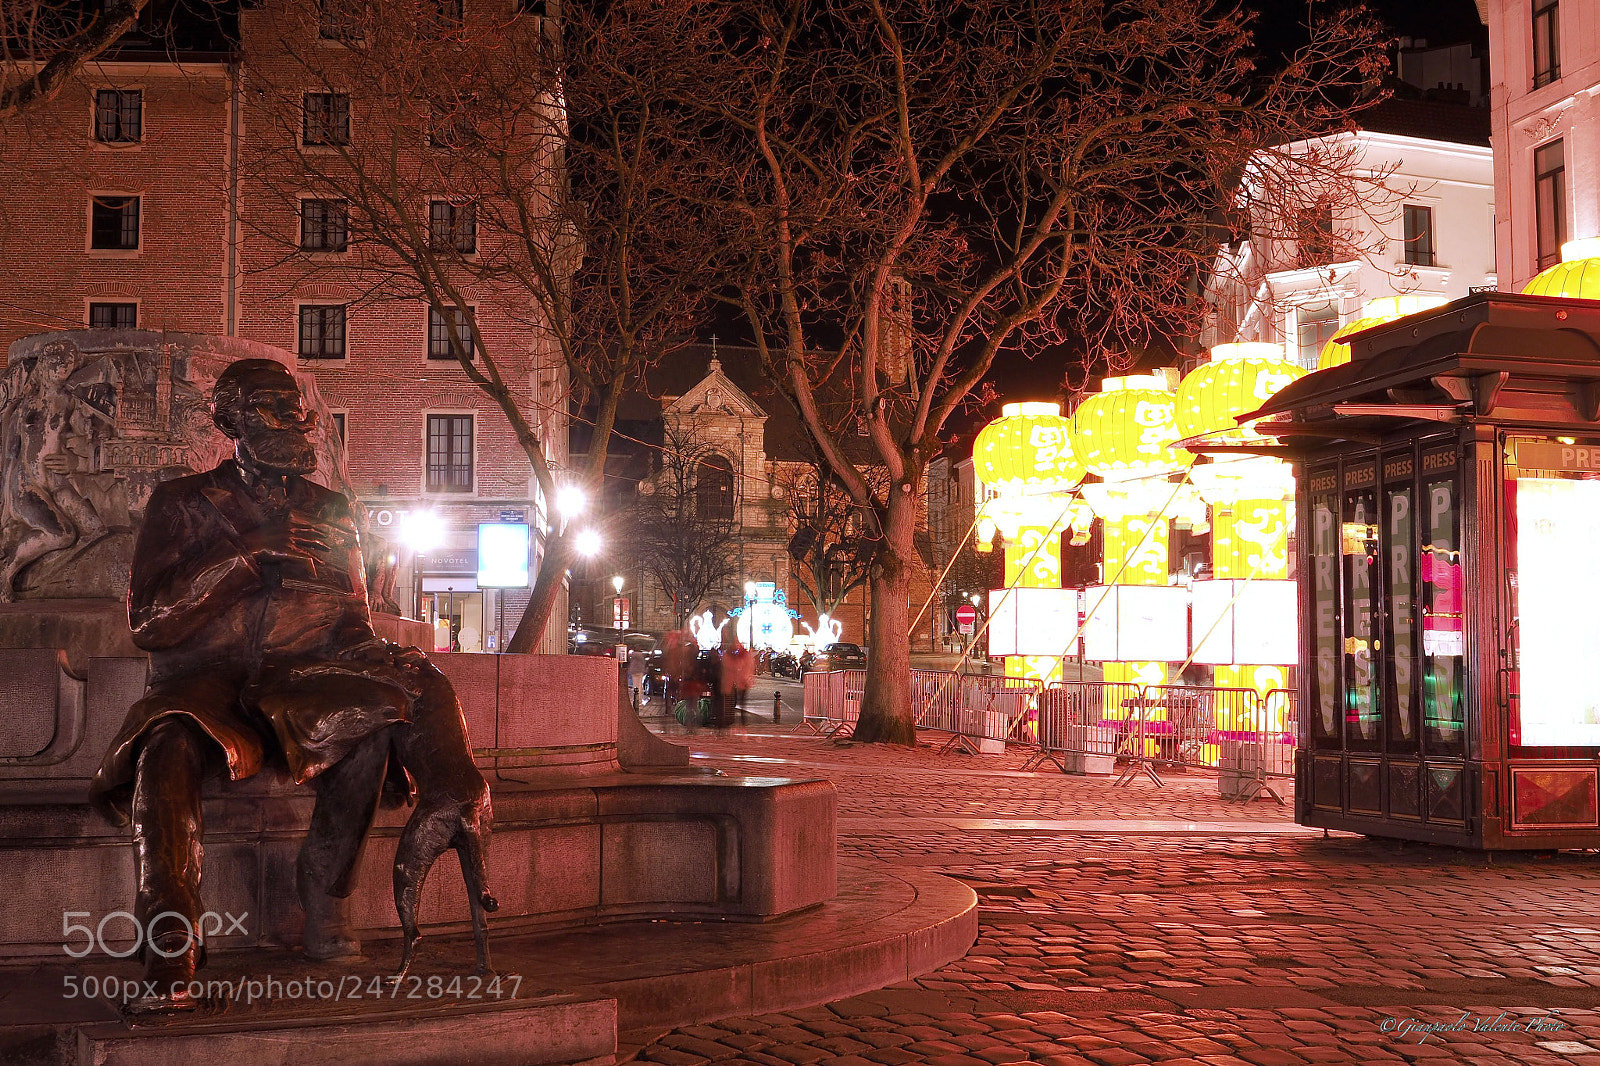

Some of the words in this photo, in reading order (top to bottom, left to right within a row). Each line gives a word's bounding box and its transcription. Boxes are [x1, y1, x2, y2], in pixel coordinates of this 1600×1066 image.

[1384, 459, 1413, 479] PRESS
[1423, 450, 1456, 470] PRESS
[1310, 475, 1336, 493] PRESS
[1345, 467, 1375, 486] PRESS
[1315, 506, 1334, 732] PRESS
[1391, 495, 1411, 735] PRESS
